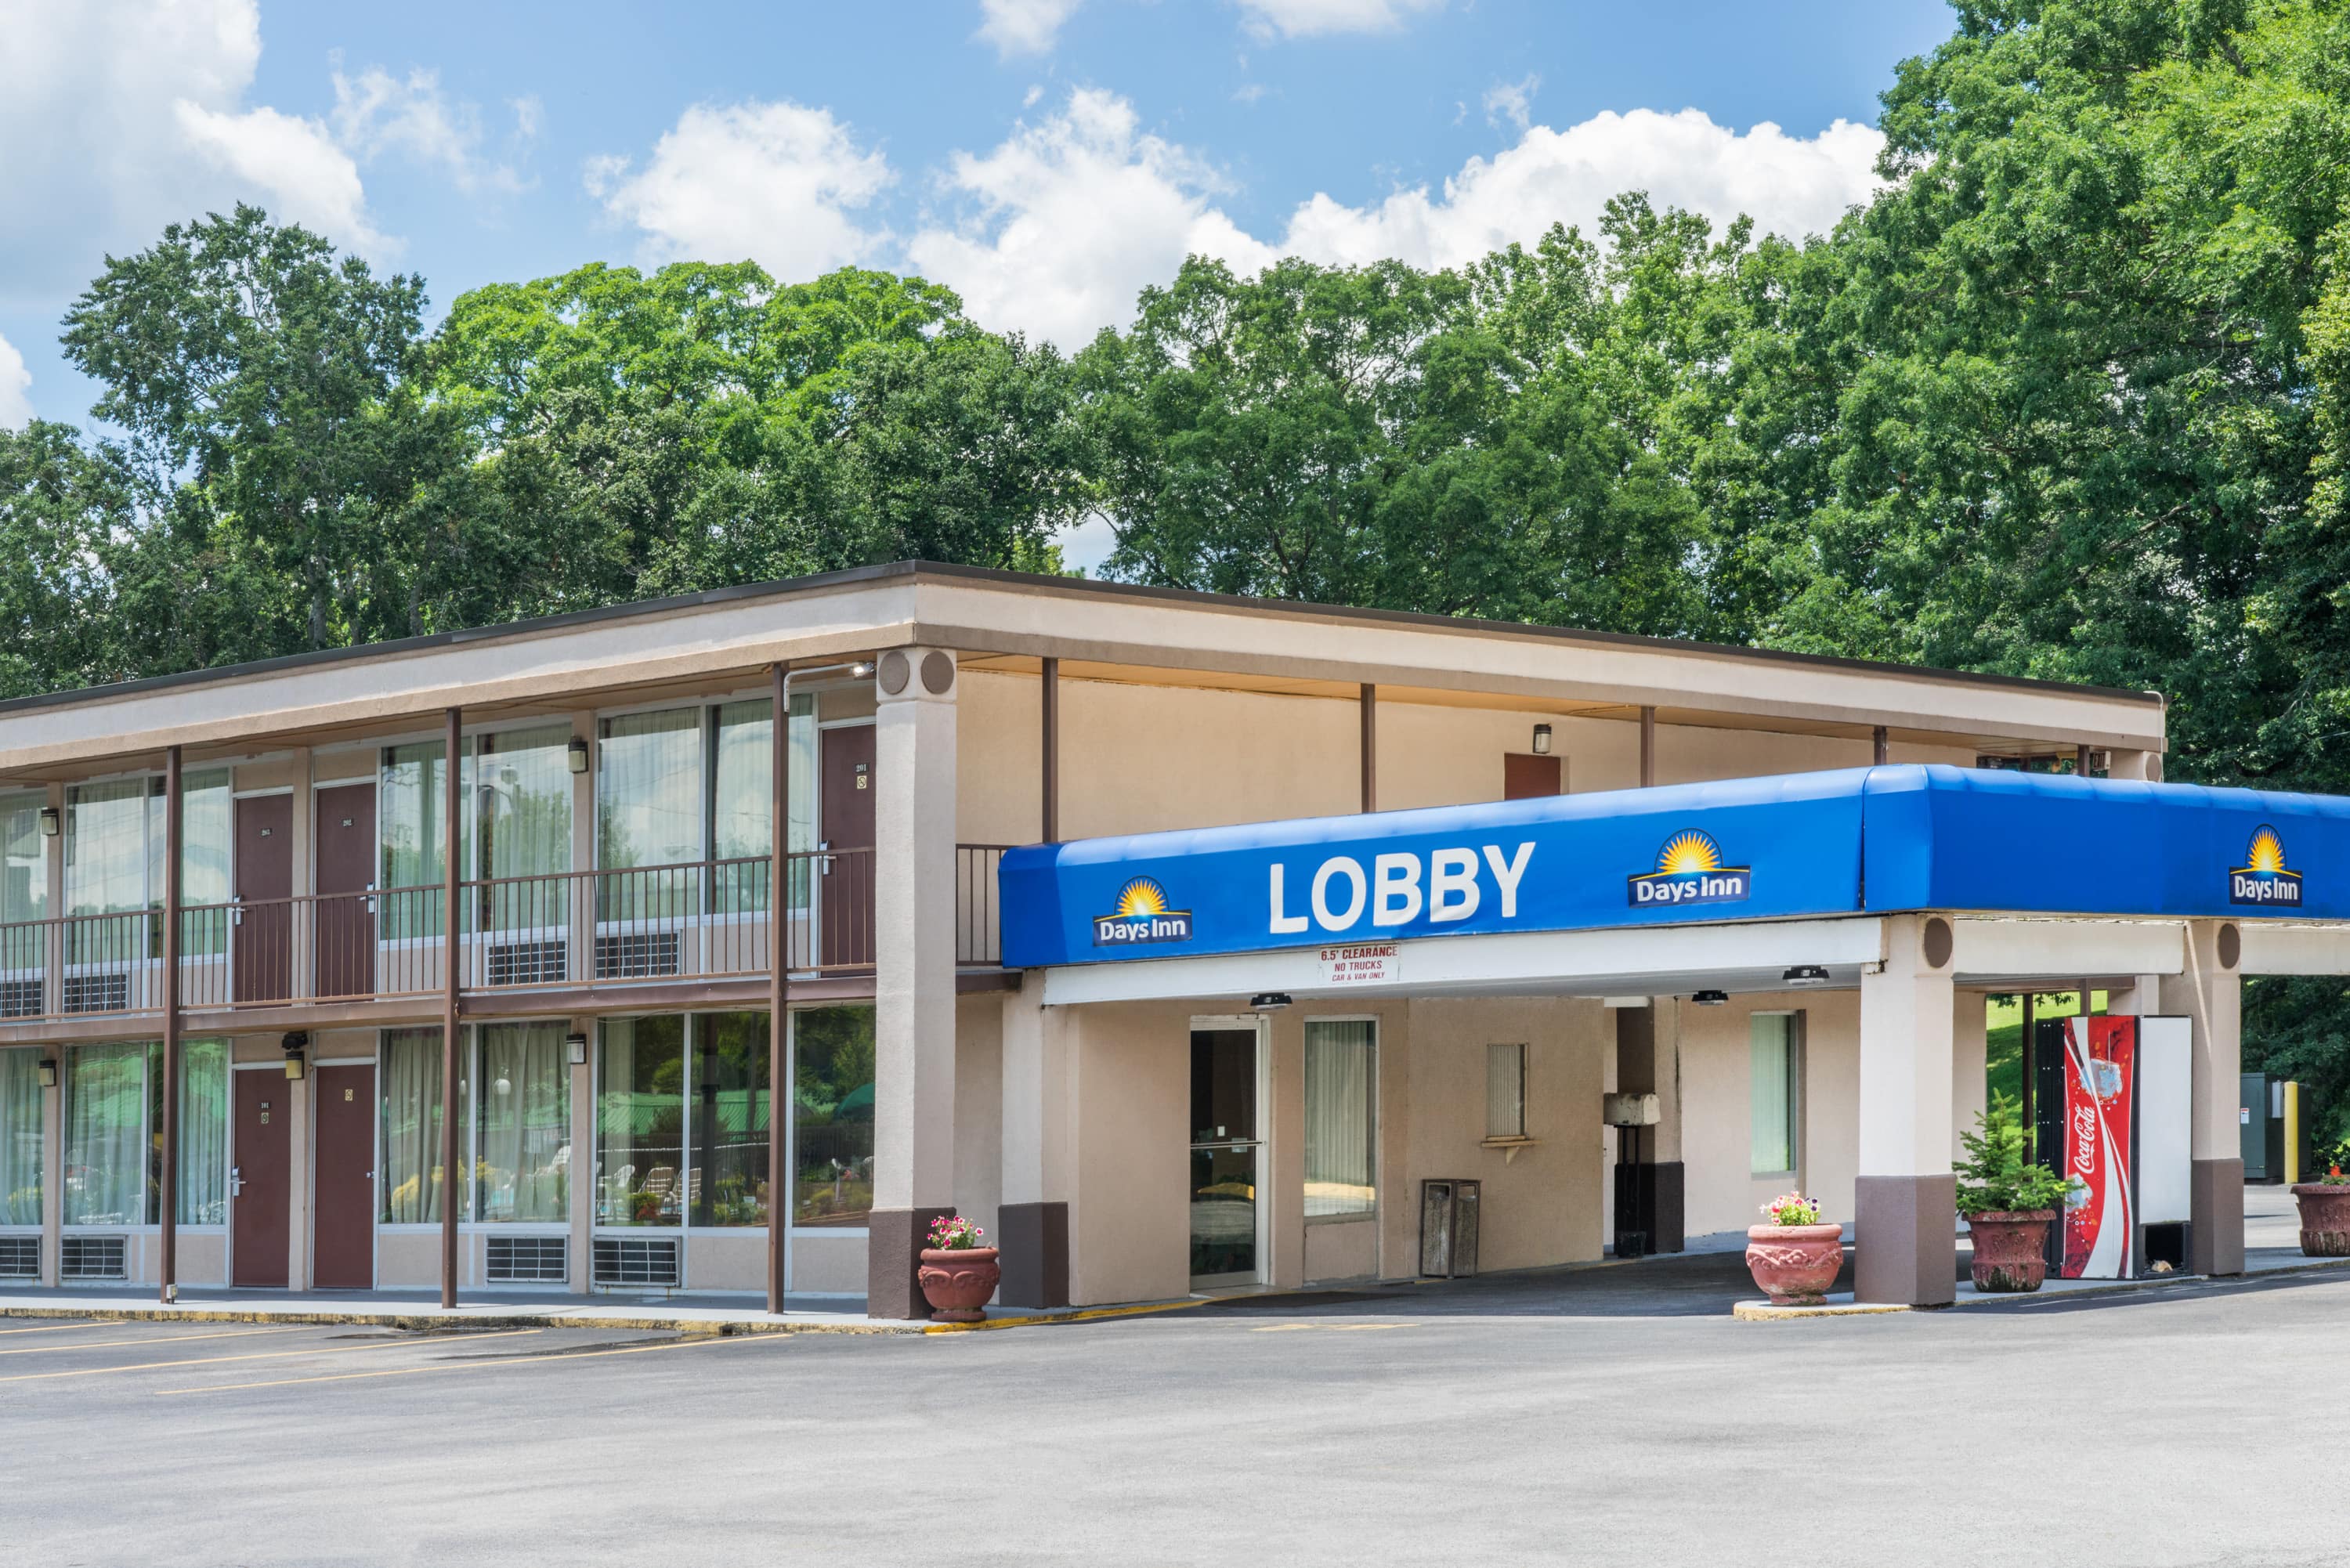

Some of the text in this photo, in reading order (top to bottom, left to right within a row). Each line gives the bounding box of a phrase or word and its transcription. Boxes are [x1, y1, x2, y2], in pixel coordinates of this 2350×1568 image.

[856, 764, 866, 772] 201
[1269, 841, 1536, 934] LOBBY
[1636, 876, 1742, 902] Days Inn
[2235, 876, 2298, 901] Days Inn
[1100, 919, 1186, 941] Days Inn
[1321, 945, 1397, 961] 6.5' CLEARANCE
[1334, 960, 1383, 972] NO TRUCKS
[1332, 974, 1345, 982] CAR
[2073, 1103, 2095, 1174] Coca-Cola
